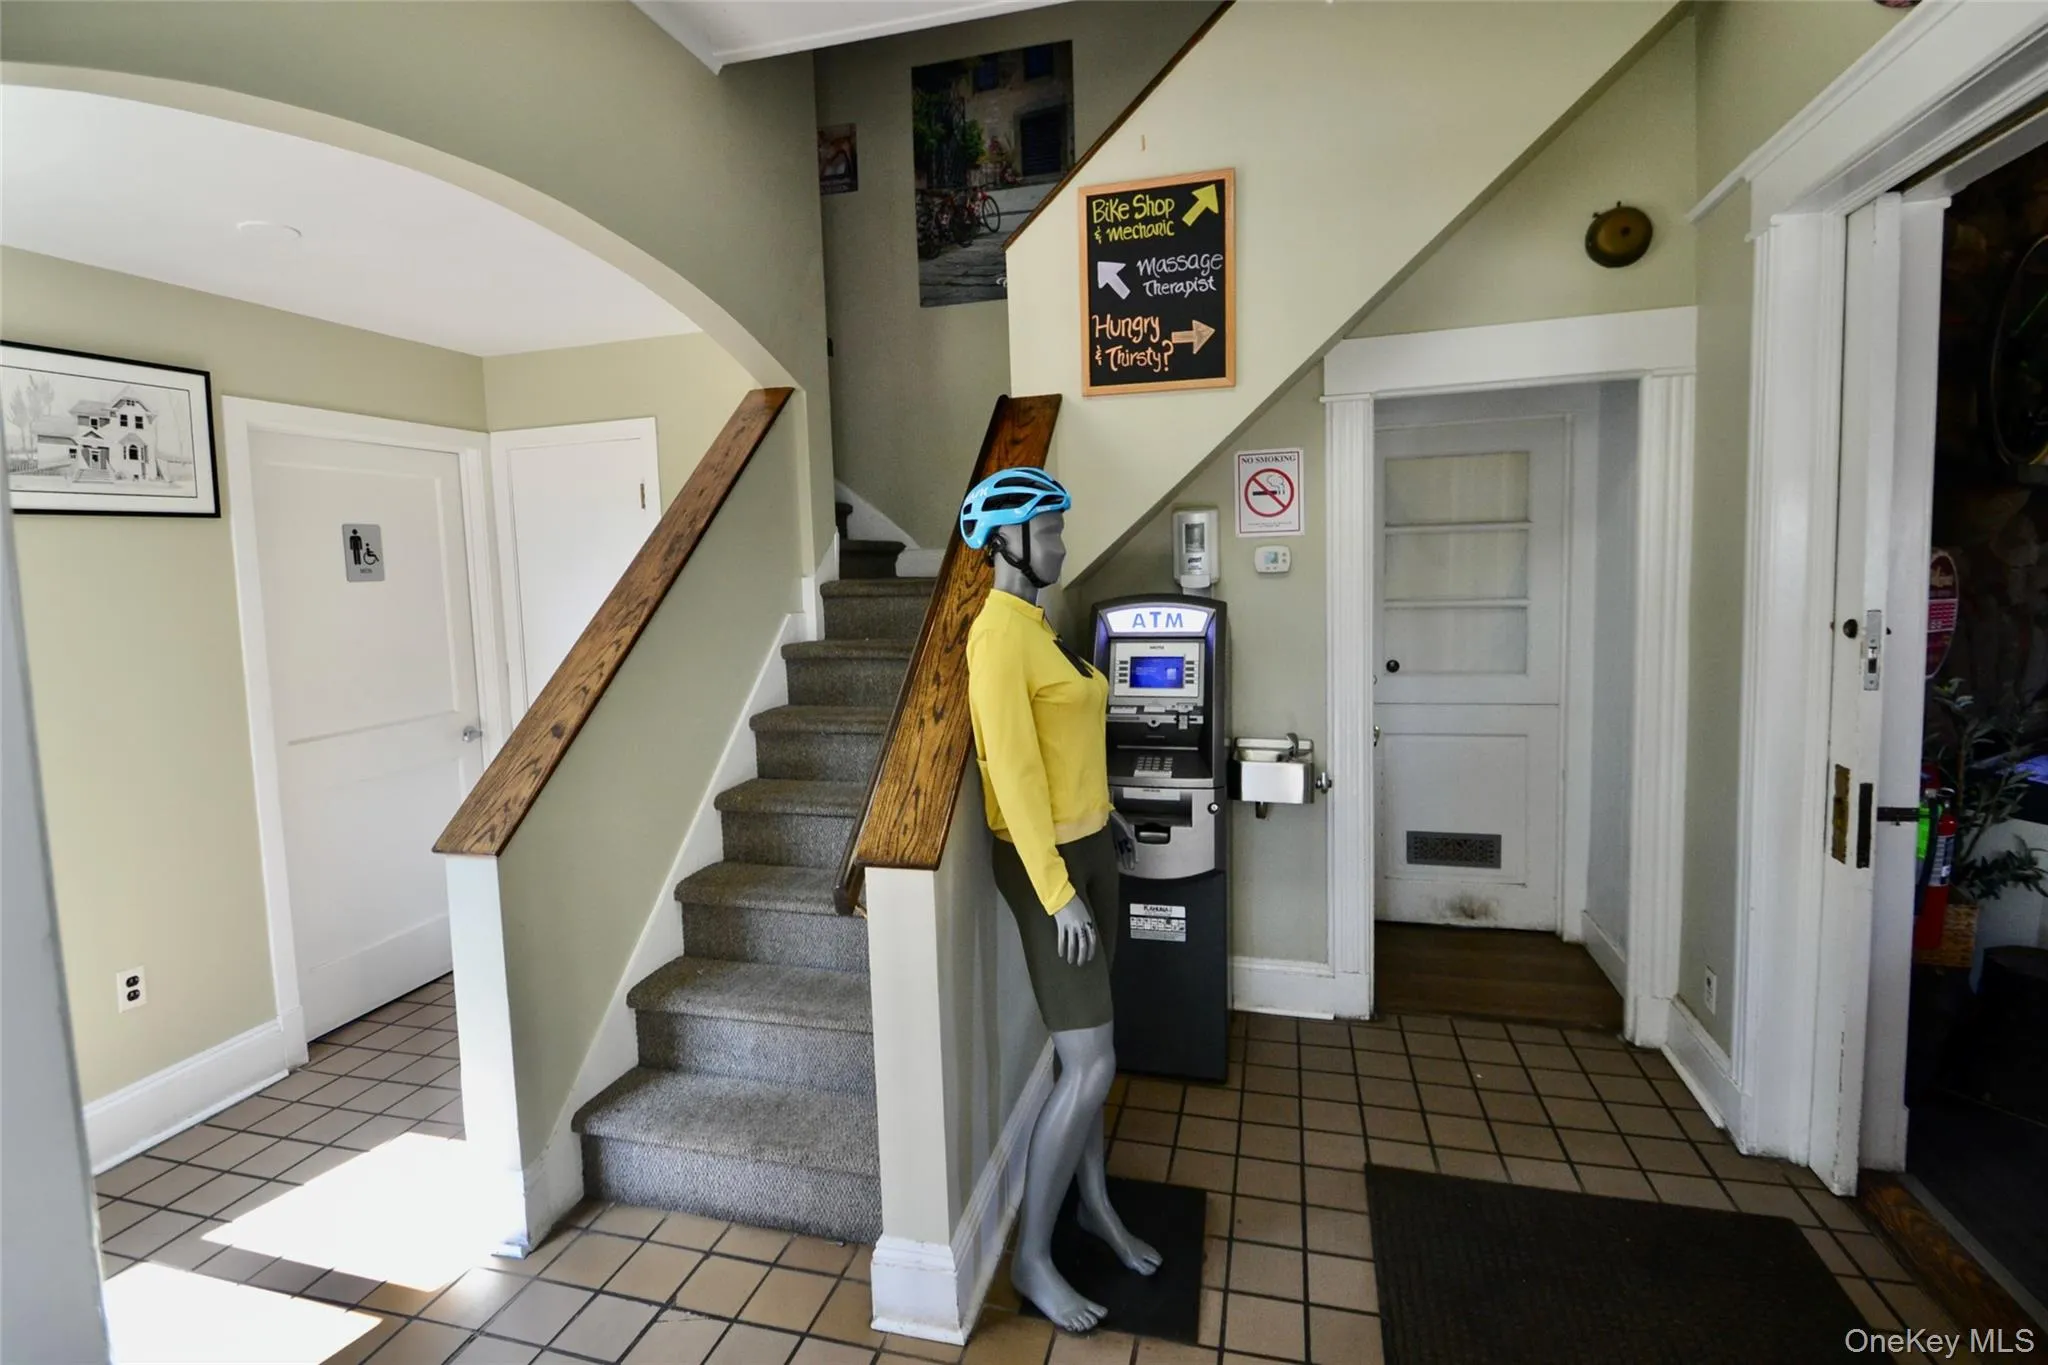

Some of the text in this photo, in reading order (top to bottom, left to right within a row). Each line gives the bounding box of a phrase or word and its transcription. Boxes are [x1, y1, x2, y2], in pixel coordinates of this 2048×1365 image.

[1133, 194, 1175, 219] Shop
[1094, 226, 1102, 244] &
[1137, 253, 1223, 278] Massage
[1143, 276, 1216, 298] Therapist
[1091, 314, 1160, 343] Hungry
[1094, 340, 1174, 372] & Thirsty?
[1255, 455, 1296, 463] SMOKING
[1132, 611, 1184, 628] ATM
